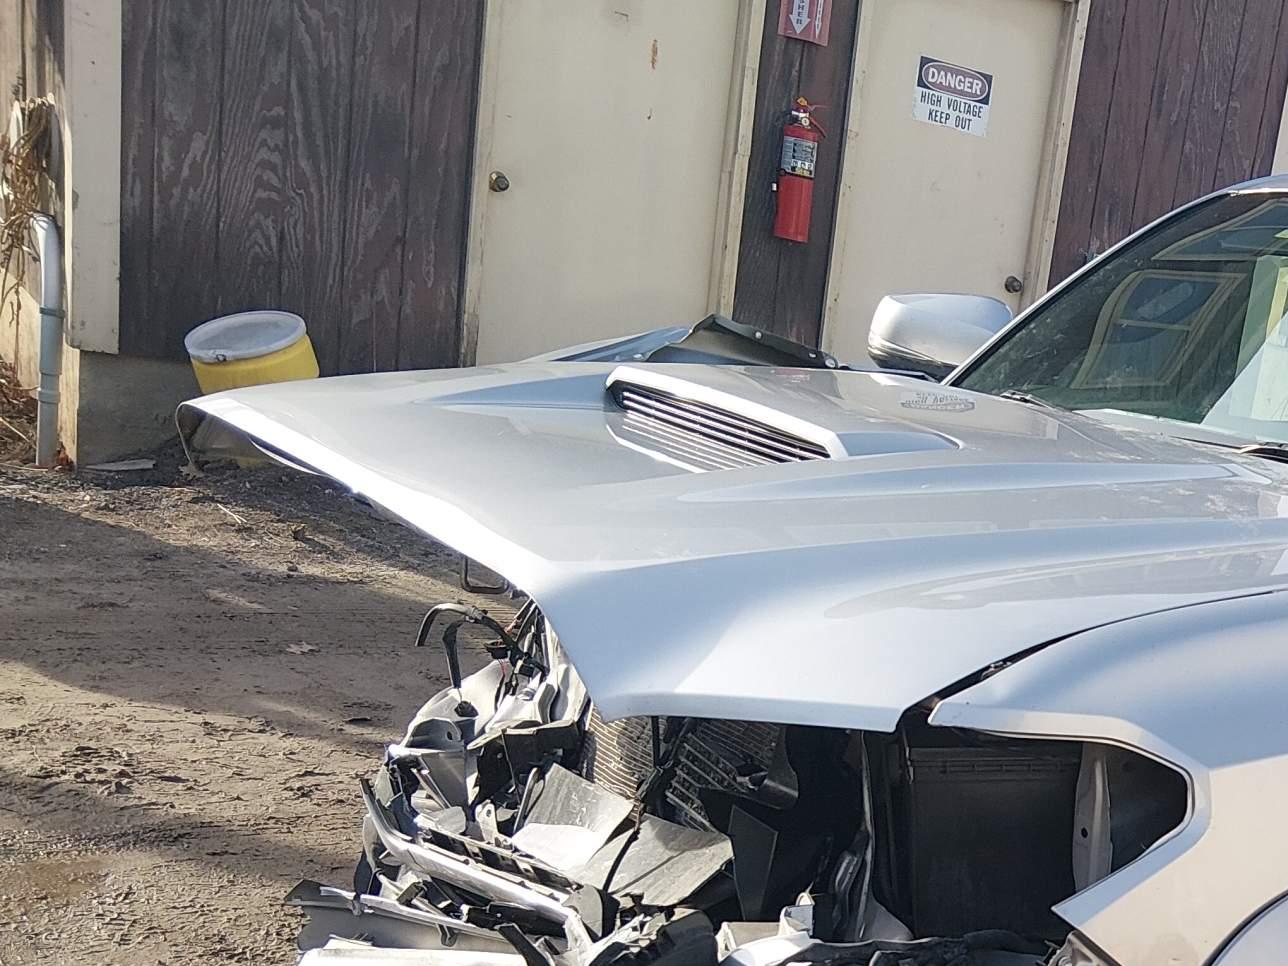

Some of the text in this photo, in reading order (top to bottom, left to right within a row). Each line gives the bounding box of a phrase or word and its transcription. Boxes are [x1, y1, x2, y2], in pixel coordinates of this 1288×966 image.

[927, 67, 983, 95] DANGER
[920, 90, 984, 119] HIGH VOLTAGE
[928, 108, 973, 131] KEEP OUT
